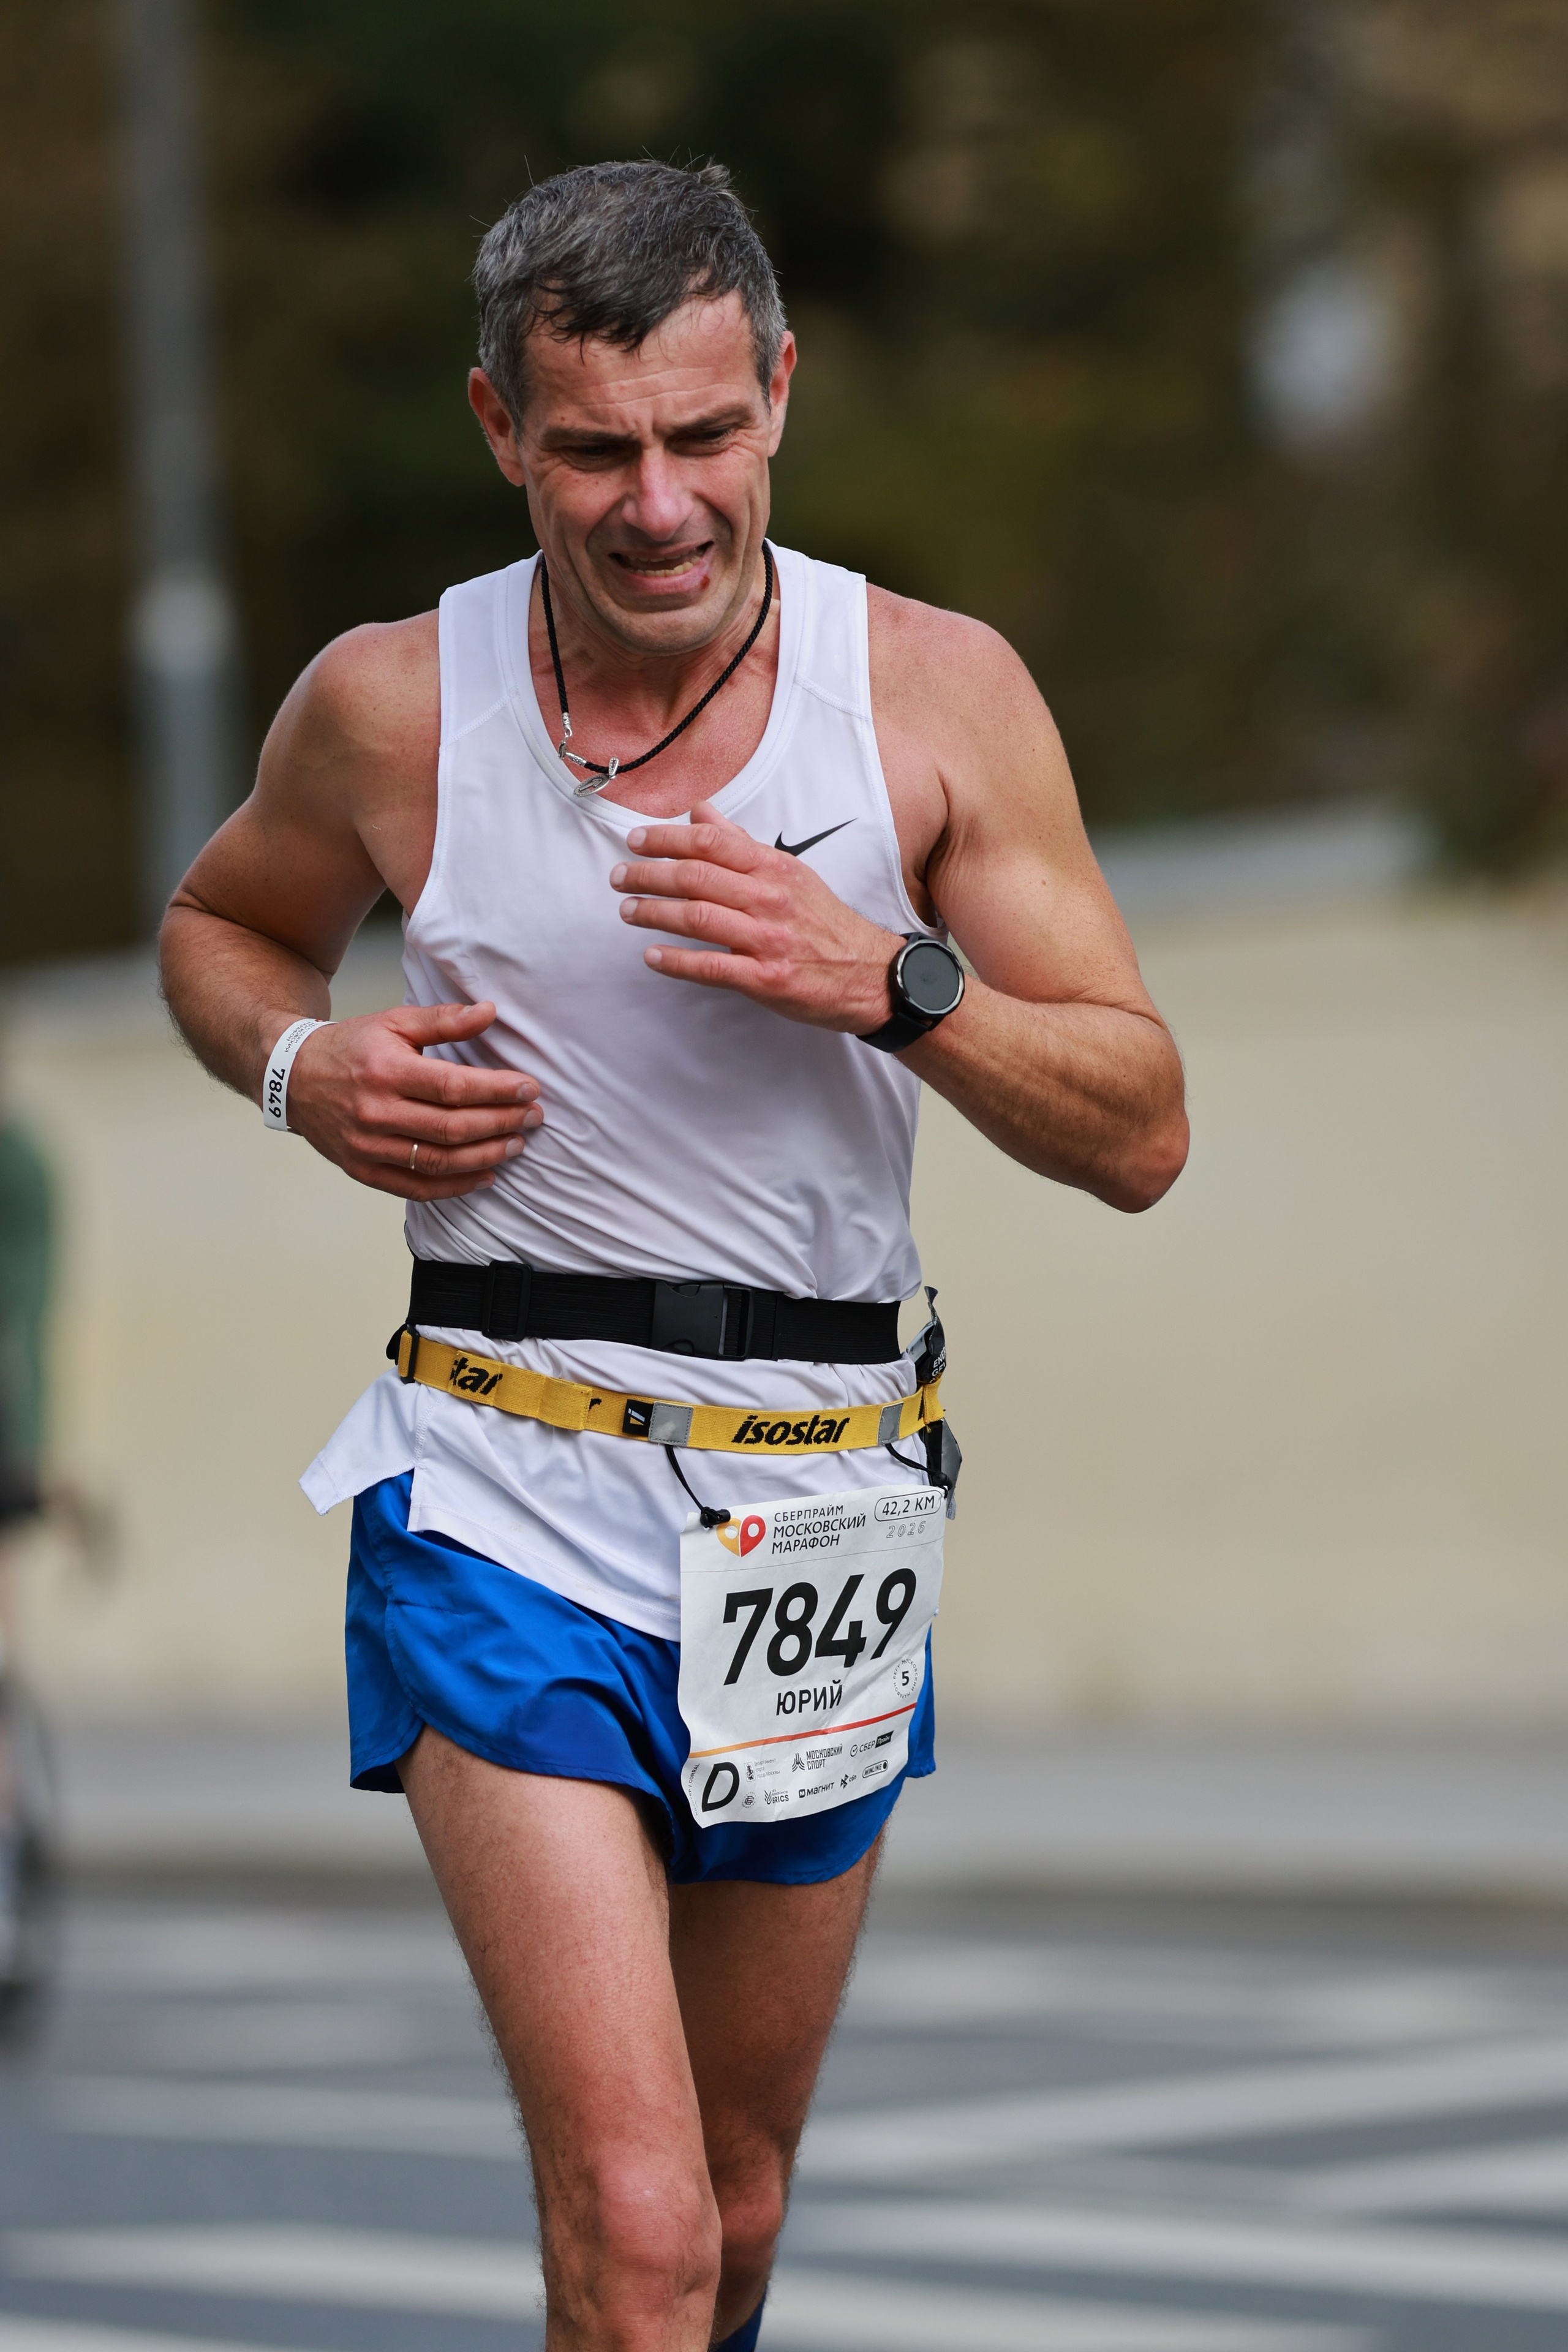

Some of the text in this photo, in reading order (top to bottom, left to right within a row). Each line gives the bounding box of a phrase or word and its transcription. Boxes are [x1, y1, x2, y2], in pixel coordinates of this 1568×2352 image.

[268, 1068, 285, 1118] 7849
[731, 1415, 850, 1446] isostar
[774, 1505, 843, 1523] СБЕРПРАЙМ
[882, 1499, 910, 1516] 42,2
[774, 1513, 866, 1539] МОСКОВСКИЙ
[886, 1520, 926, 1539] 2026
[772, 1534, 840, 1555] МАРАФОН
[723, 1568, 917, 1686] 7849
[902, 1670, 910, 1686] 5
[776, 1679, 843, 1716] ЮРИЙ
[806, 1744, 843, 1760] МОСКОВСКИЙ
[859, 1740, 875, 1752] СБЕР
[689, 1763, 699, 1783] CORRAL
[807, 1759, 826, 1770] СПОРТ
[864, 1763, 883, 1776] WINLINE
[701, 1762, 739, 1812] D
[772, 1794, 789, 1804] BRICS
